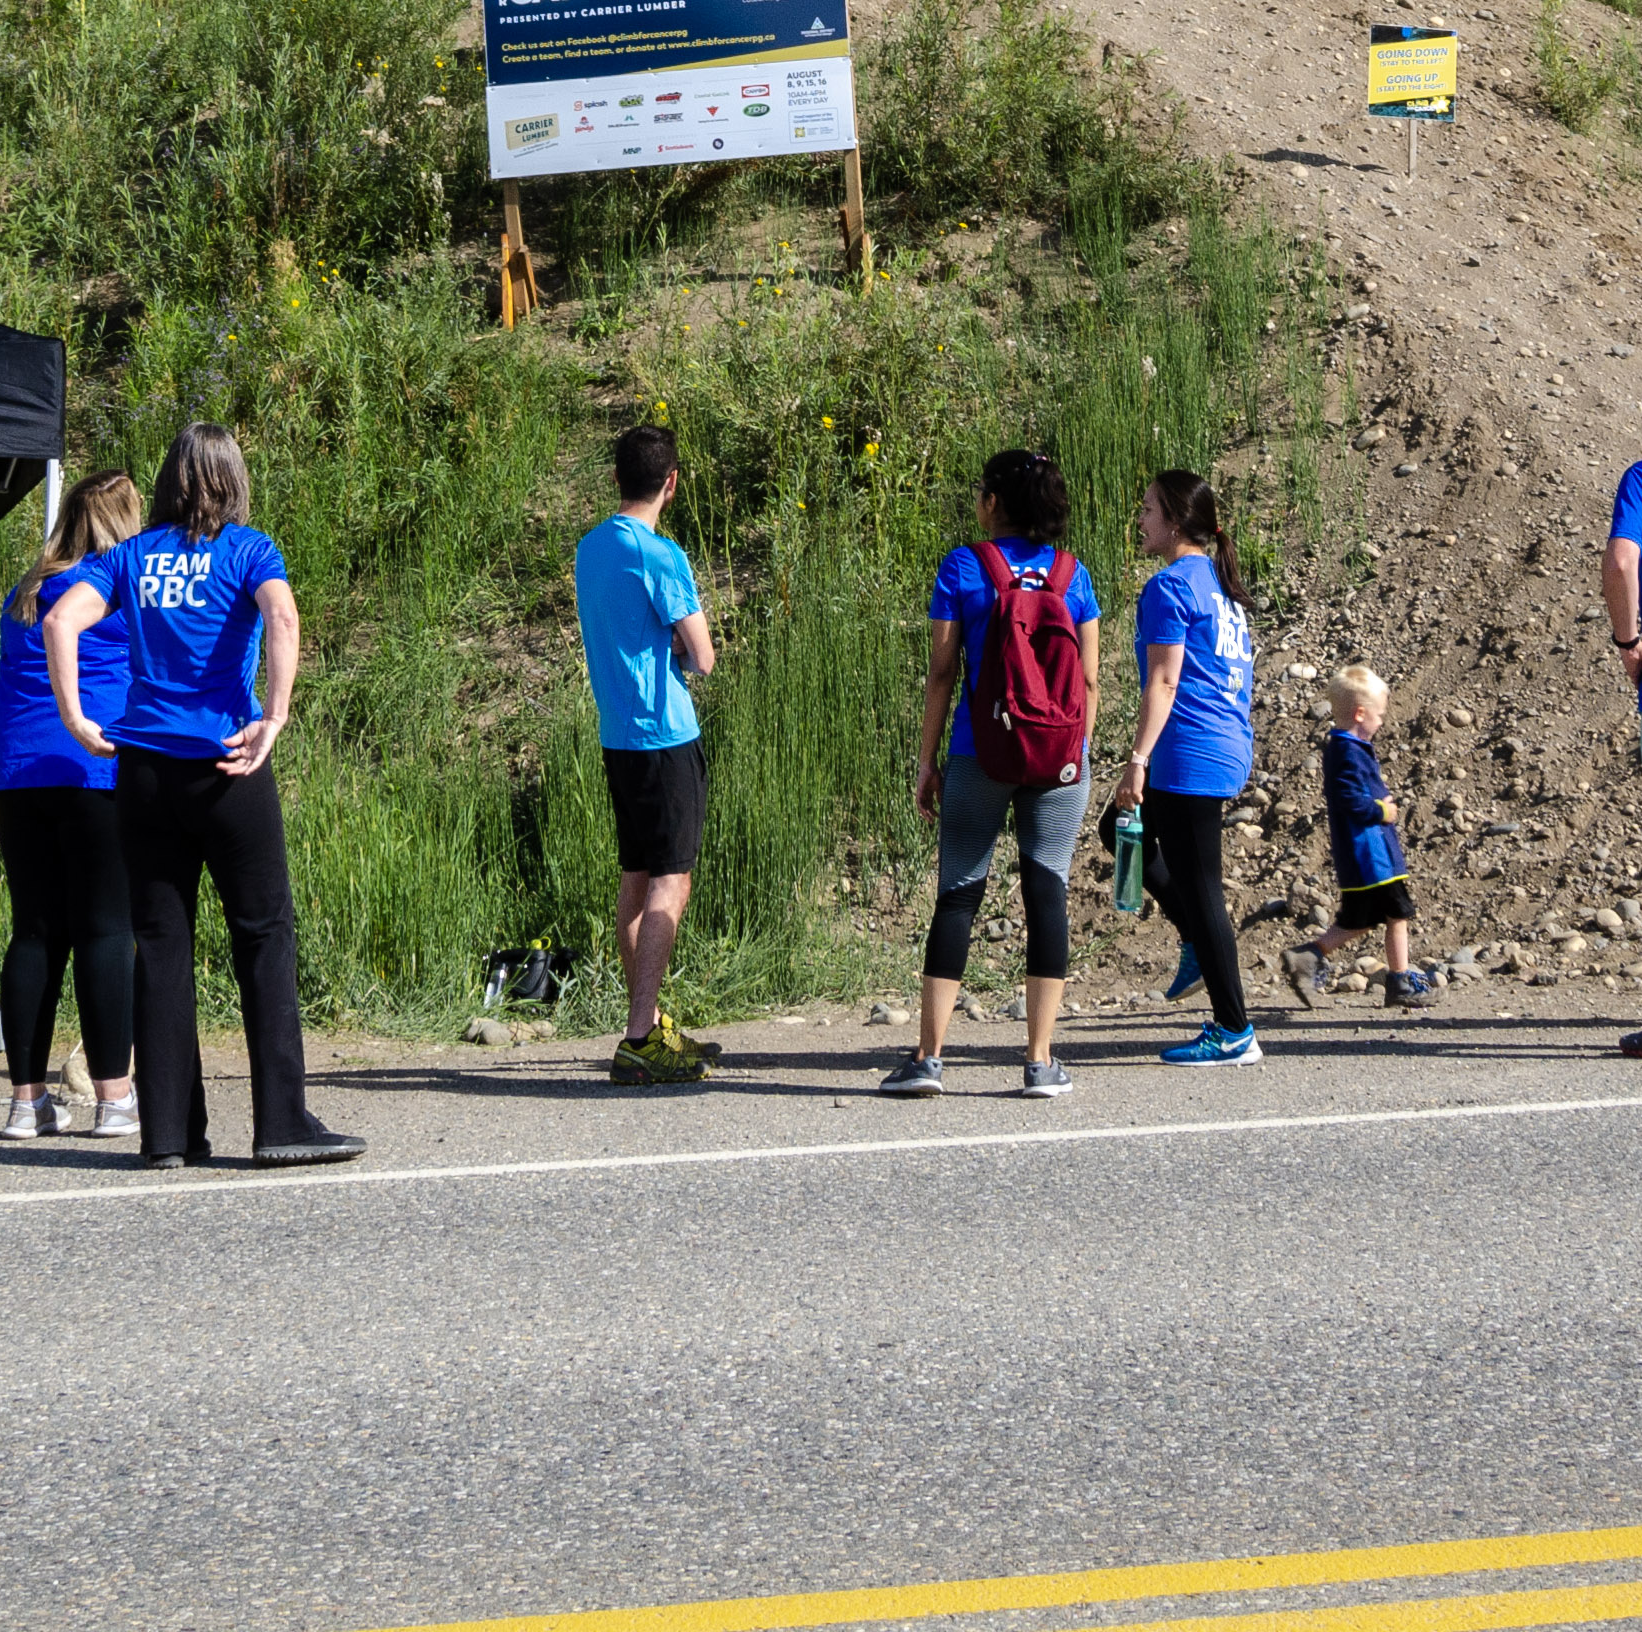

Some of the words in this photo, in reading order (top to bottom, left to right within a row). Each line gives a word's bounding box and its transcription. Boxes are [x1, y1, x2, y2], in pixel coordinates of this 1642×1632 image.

[500, 12, 560, 24] PRESENTED
[564, 10, 577, 18] BY
[581, 5, 633, 17] CARRIER
[637, 0, 686, 12] LUMBER
[502, 42, 526, 51] Check
[567, 36, 607, 46] Facebook
[503, 55, 531, 63] Create
[565, 49, 581, 58] find
[625, 44, 655, 52] donate
[1377, 49, 1412, 59] GOING
[1415, 48, 1448, 57] DOWN
[787, 70, 823, 80] AUGUST
[1387, 74, 1421, 84] GOING
[1425, 73, 1438, 82] UP
[788, 98, 812, 106] EVERY
[515, 118, 553, 134] CARRIER
[522, 130, 549, 142] LUMBER
[144, 552, 211, 576] TEAM
[139, 575, 207, 608] RBC
